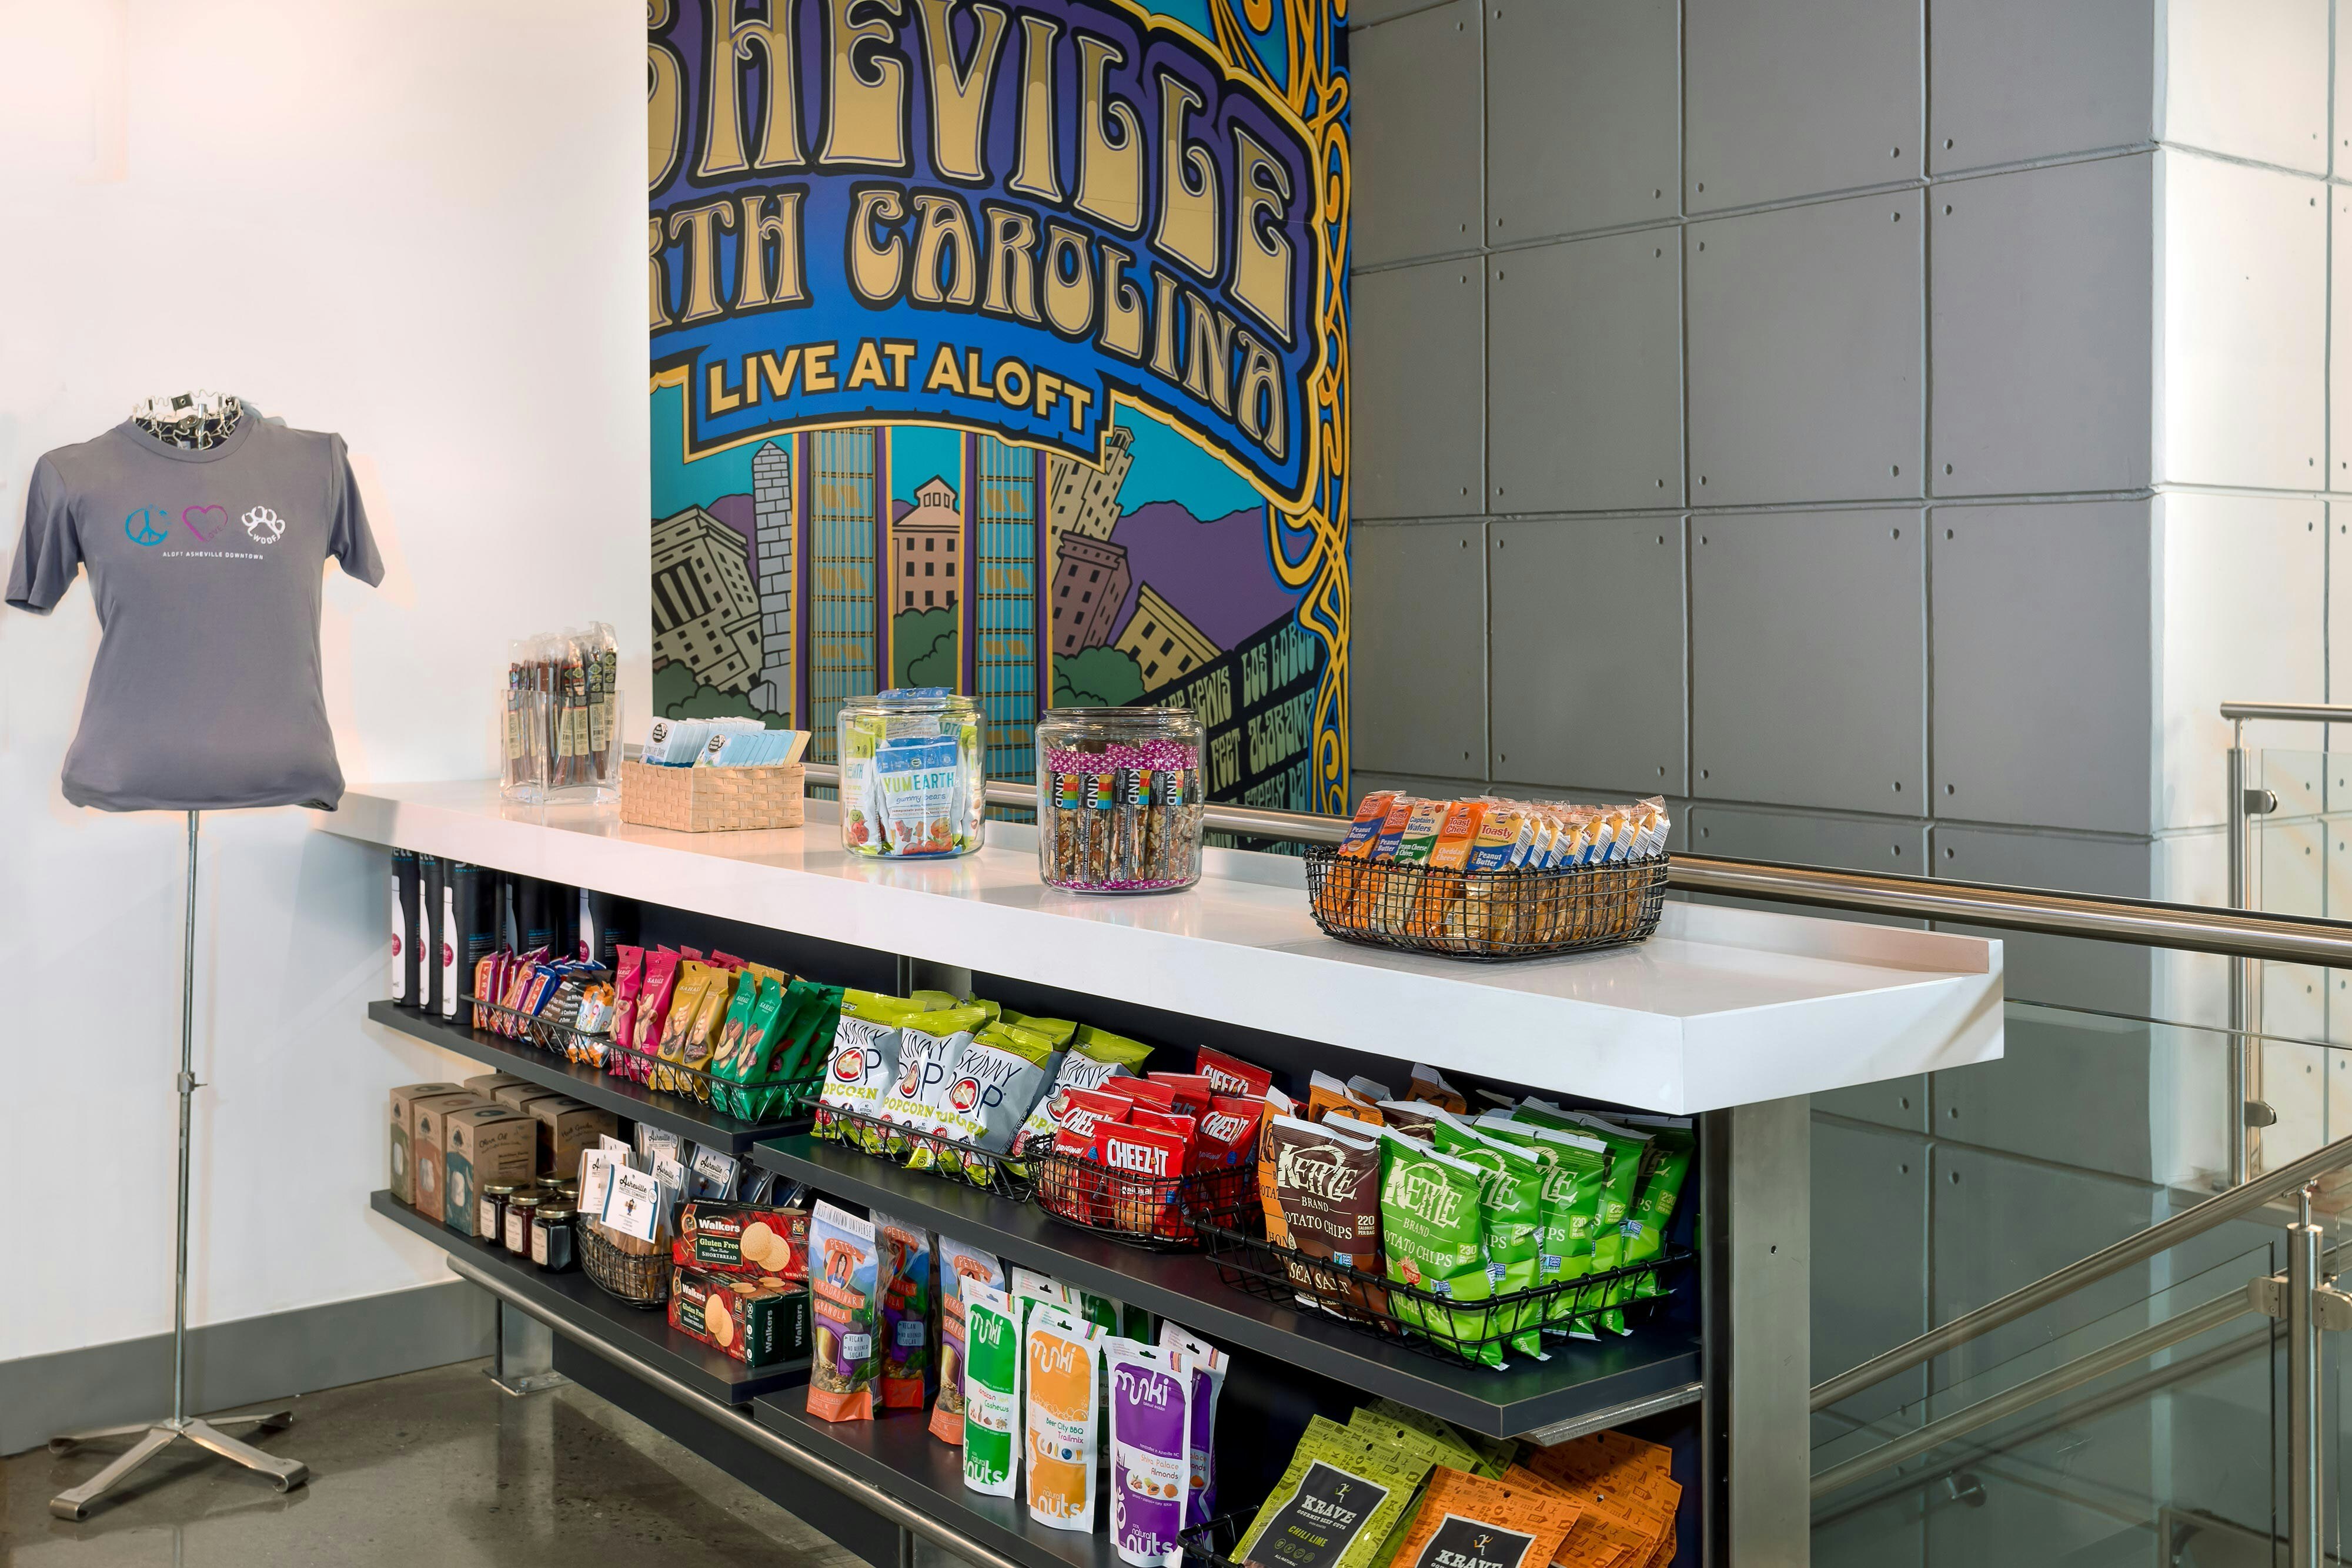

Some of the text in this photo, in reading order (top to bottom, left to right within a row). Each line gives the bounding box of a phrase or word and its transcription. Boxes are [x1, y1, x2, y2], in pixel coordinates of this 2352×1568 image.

[853, 190, 1287, 459] CAROLINA
[710, 344, 1091, 430] LIVE AT ALOFT
[253, 533, 277, 544] WOOF
[1241, 642, 1268, 707] LOS
[1211, 728, 1240, 793] FEET
[883, 772, 954, 794] YUMEARTH
[1055, 772, 1065, 808] KIND
[1087, 774, 1100, 809] KIND
[1128, 769, 1140, 804] KIND
[1167, 771, 1176, 805] KIND
[896, 795, 921, 804] gummy
[1446, 825, 1467, 834] Chee
[1449, 817, 1471, 827] Toast
[1482, 824, 1514, 839] Toasty
[1438, 847, 1465, 855] Cheddar
[1478, 851, 1502, 860] Peanut
[1476, 858, 1498, 867] Butter
[837, 1019, 890, 1046] SKINNY
[956, 1049, 1023, 1087] SKINNY
[823, 1082, 878, 1101] OPCORN
[883, 1096, 936, 1118] POPCORN
[649, 1130, 671, 1142] Asheville
[700, 1155, 723, 1174] Asheville
[1278, 1142, 1358, 1203] KETTLE
[619, 1174, 647, 1193] Asheville
[619, 1186, 647, 1199] PRETZEL COMPANY
[1381, 1156, 1463, 1229] KETTLE
[1661, 1192, 1676, 1205] 230
[1302, 1196, 1329, 1212] BRAND
[1609, 1203, 1625, 1215] 230
[699, 1219, 740, 1233] Walkers
[833, 1211, 847, 1228] KNOWN
[849, 1218, 871, 1238] UNIVERSE
[1285, 1211, 1352, 1239] OTATO CHIPS
[1358, 1215, 1375, 1226] 220
[1403, 1217, 1430, 1238] BRAND
[1572, 1216, 1586, 1228] 230
[887, 1226, 912, 1243] PETE'S
[699, 1238, 739, 1249] Gluten Free
[830, 1239, 857, 1255] PETE'S
[1384, 1229, 1415, 1253] OTATO
[1416, 1245, 1454, 1268] CHIPS
[1459, 1244, 1477, 1255] 230
[701, 1251, 737, 1261] SHORTBREAD
[958, 1256, 985, 1273] PETE'S
[1289, 1262, 1312, 1285] SEA
[681, 1283, 706, 1302] Walkers
[816, 1281, 865, 1306] TRAORDINARY
[682, 1302, 704, 1319] Gluten Free
[817, 1300, 846, 1320] GRANOLA
[683, 1316, 704, 1330] SHORTBREAD
[944, 1316, 965, 1338] GRANOL
[984, 1399, 1010, 1412] Cashews
[1046, 1417, 1084, 1435] Beer City BBQ
[1317, 1419, 1335, 1430] CHOMP
[1058, 1431, 1084, 1444] Trailmix
[971, 1455, 986, 1467] natural
[1141, 1454, 1179, 1469] Shiva Palace
[966, 1460, 1003, 1486] nuts
[1151, 1467, 1179, 1479] Almonds
[1444, 1470, 1465, 1482] CHOMP
[1517, 1470, 1540, 1485] CHOMP
[1509, 1477, 1531, 1490] CHOMP
[1043, 1490, 1061, 1500] natural
[1038, 1493, 1081, 1519] nuts
[1301, 1494, 1358, 1524] KRAVE
[1297, 1509, 1347, 1530] GOURMET BEEF CUTS
[1131, 1528, 1152, 1540] natural
[1287, 1525, 1329, 1547] CHILI LIME
[1126, 1532, 1174, 1557] nuts
